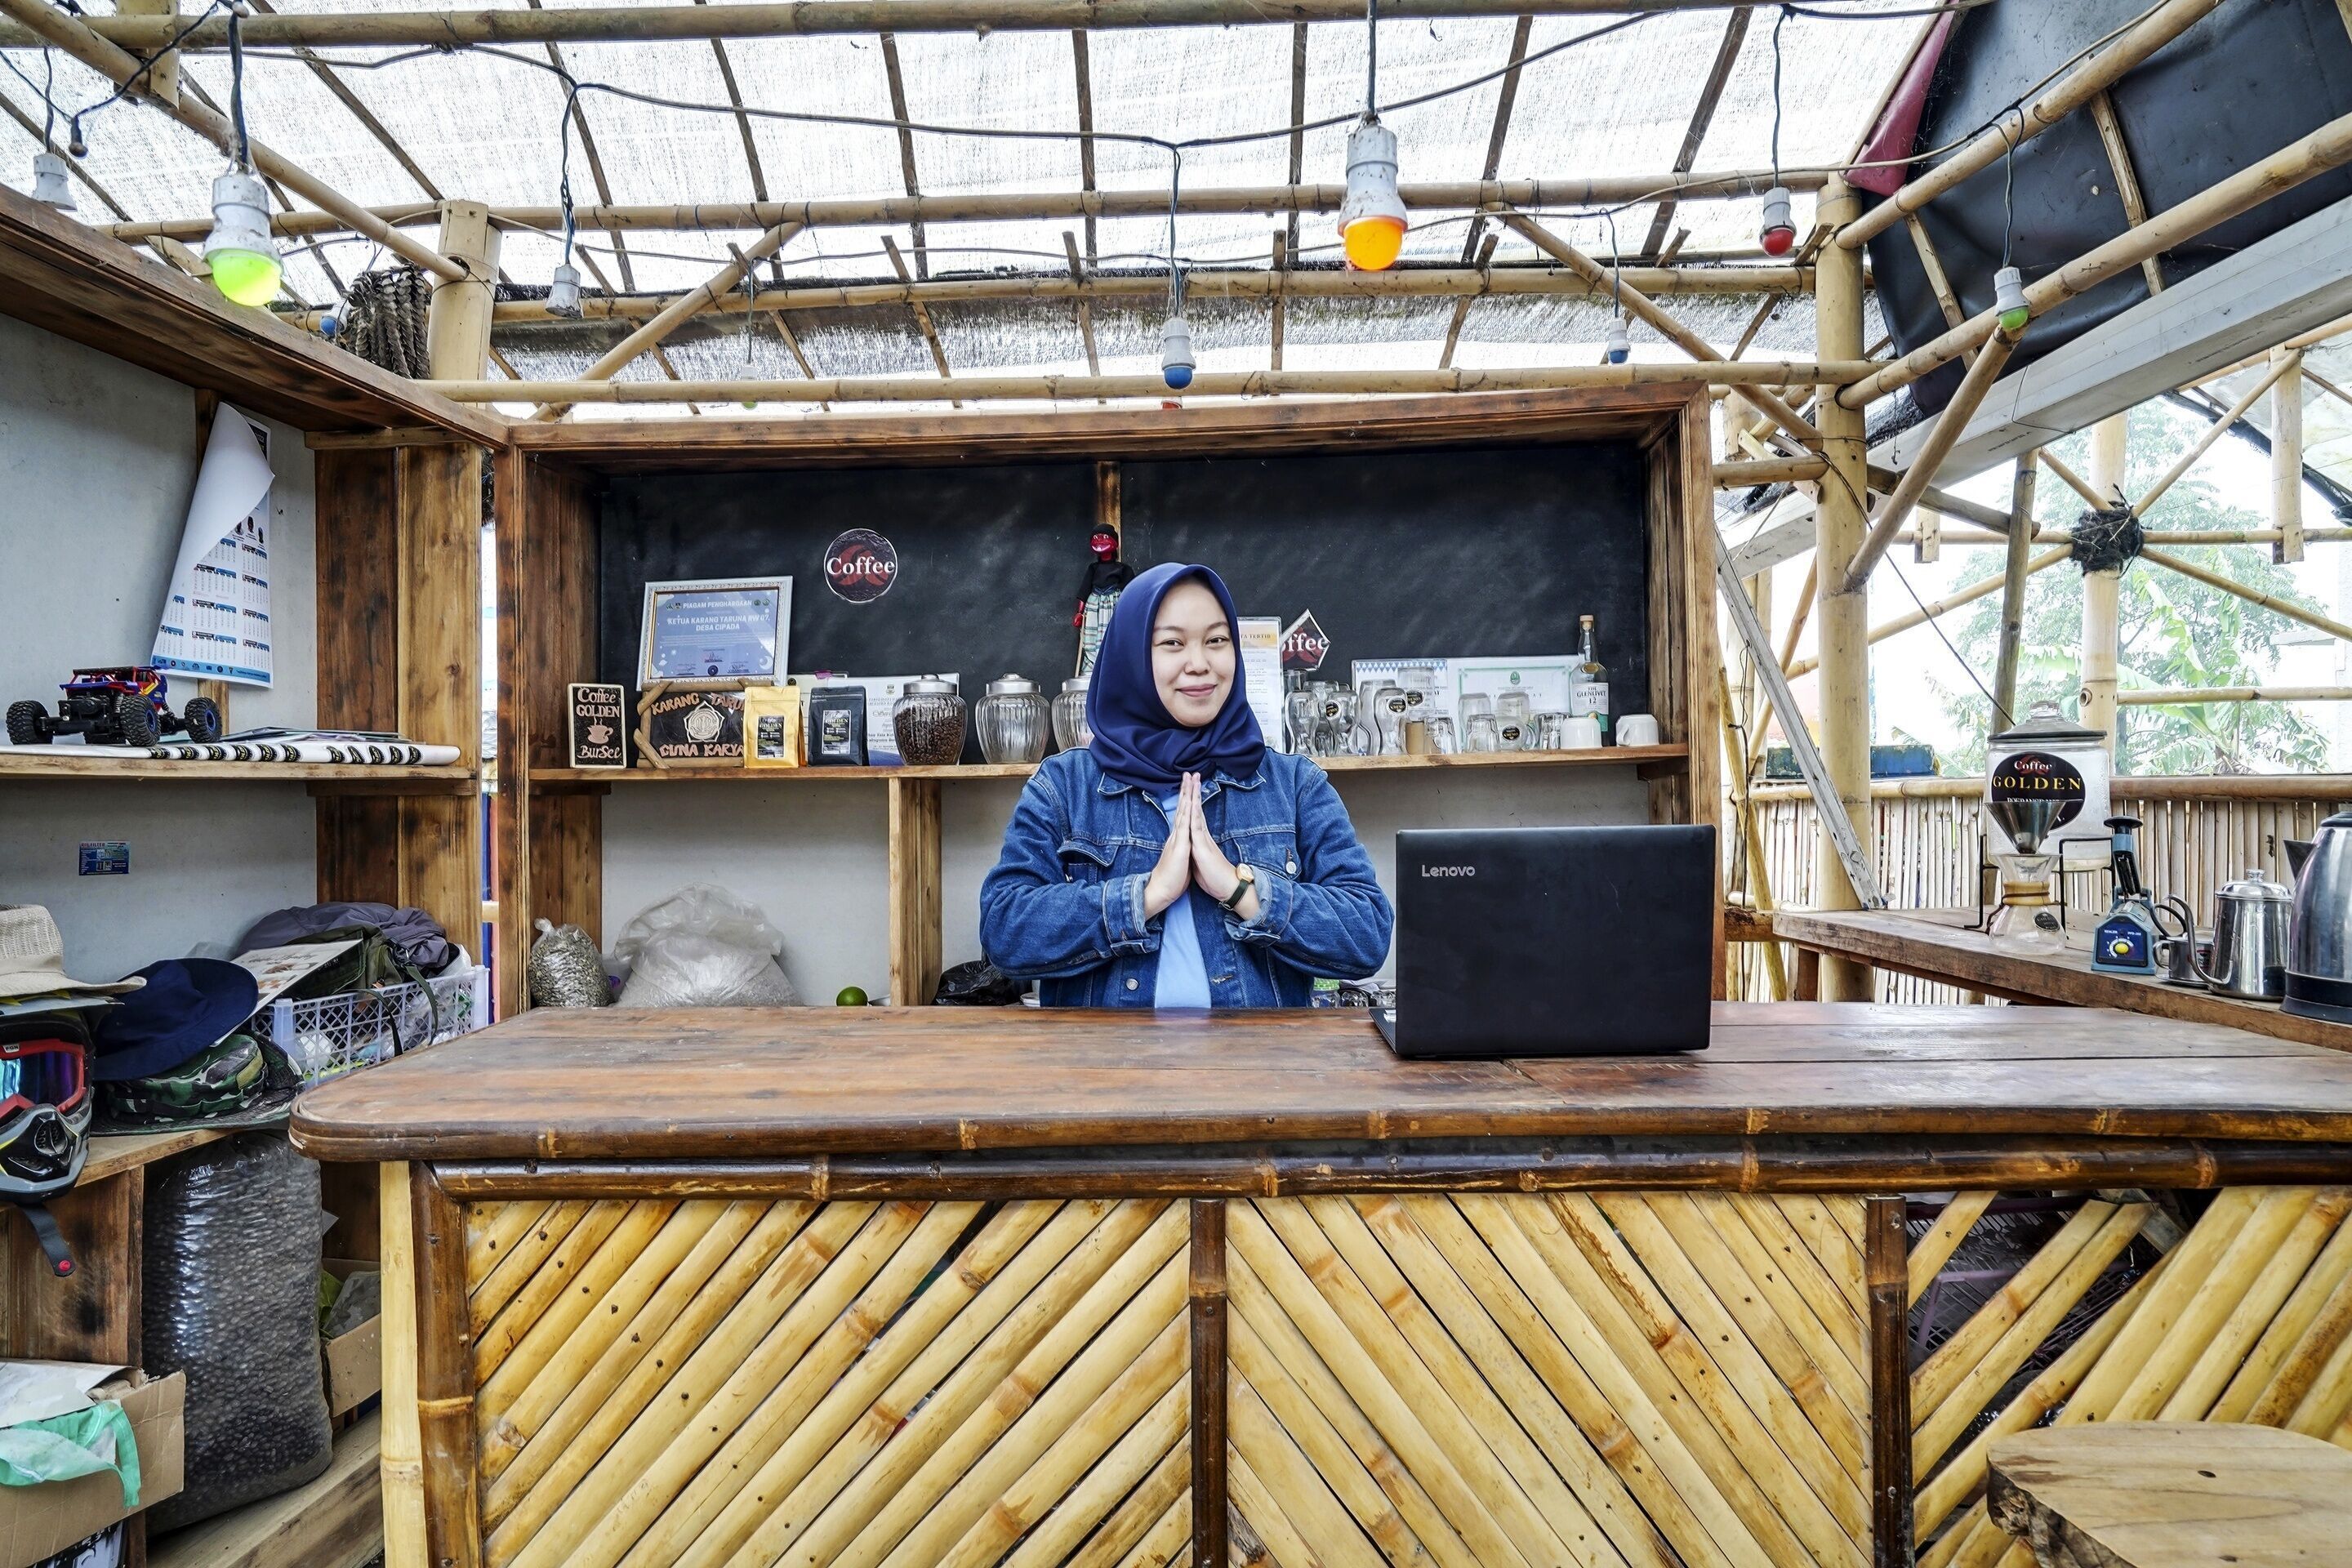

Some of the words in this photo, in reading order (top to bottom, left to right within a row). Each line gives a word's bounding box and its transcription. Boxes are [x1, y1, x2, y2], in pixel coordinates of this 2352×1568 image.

[826, 556, 895, 575] Coffee
[707, 599, 752, 608] PENGHARGAAN
[691, 617, 719, 625] KARANG
[719, 615, 747, 623] TARUNA
[715, 622, 740, 630] CIPADA
[1281, 633, 1329, 653] ffee
[577, 688, 617, 703] Coffee
[651, 692, 700, 715] KARANG
[710, 692, 745, 711] TARU
[576, 704, 621, 718] GOLDEN
[2014, 760, 2052, 771] Coffee
[1993, 776, 2082, 791] GOLDEN
[1421, 864, 1476, 877] Lenovo
